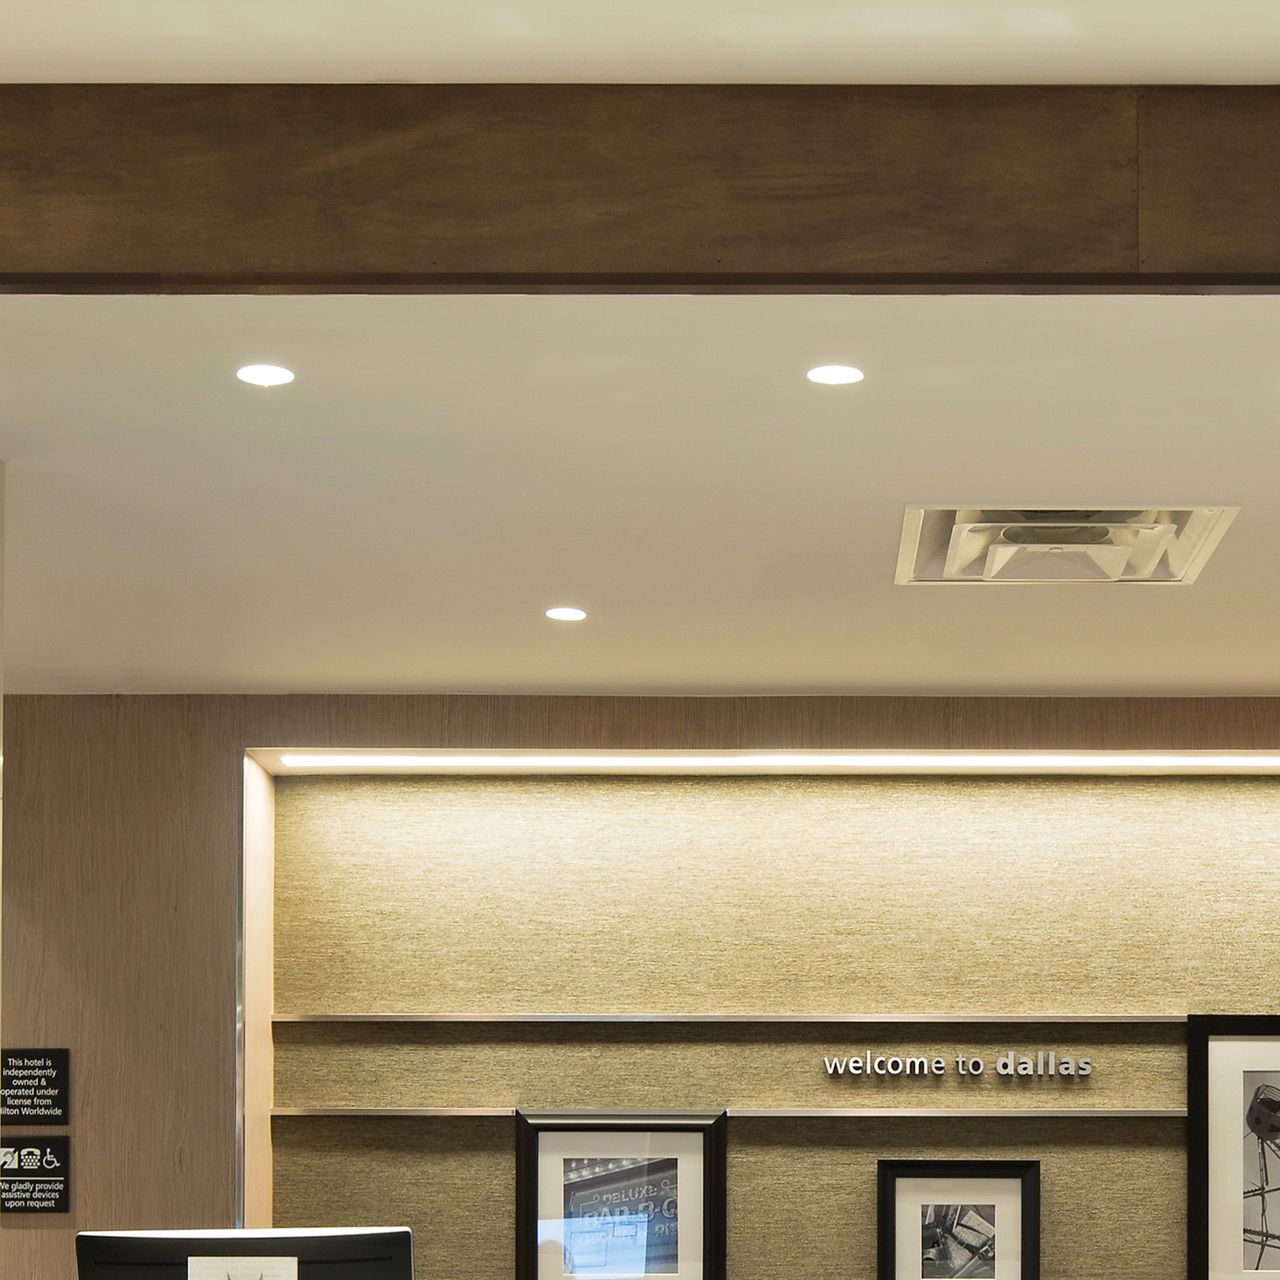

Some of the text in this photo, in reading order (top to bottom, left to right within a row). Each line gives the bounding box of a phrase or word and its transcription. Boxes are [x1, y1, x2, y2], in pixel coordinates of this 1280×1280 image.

[8, 1058, 52, 1067] This hotel is
[824, 1050, 1093, 1075] welcome to dallas
[2, 1068, 57, 1078] independently
[12, 1078, 47, 1086] owned &
[0, 1088, 59, 1097] operated under
[6, 1097, 52, 1106] license from
[21, 1107, 63, 1116] Worldwide
[10, 1181, 34, 1192] gladly
[35, 1181, 64, 1192] provide
[0, 1189, 60, 1199] assistive devices
[602, 1185, 658, 1205] DELUXE
[4, 1200, 56, 1209] upon request
